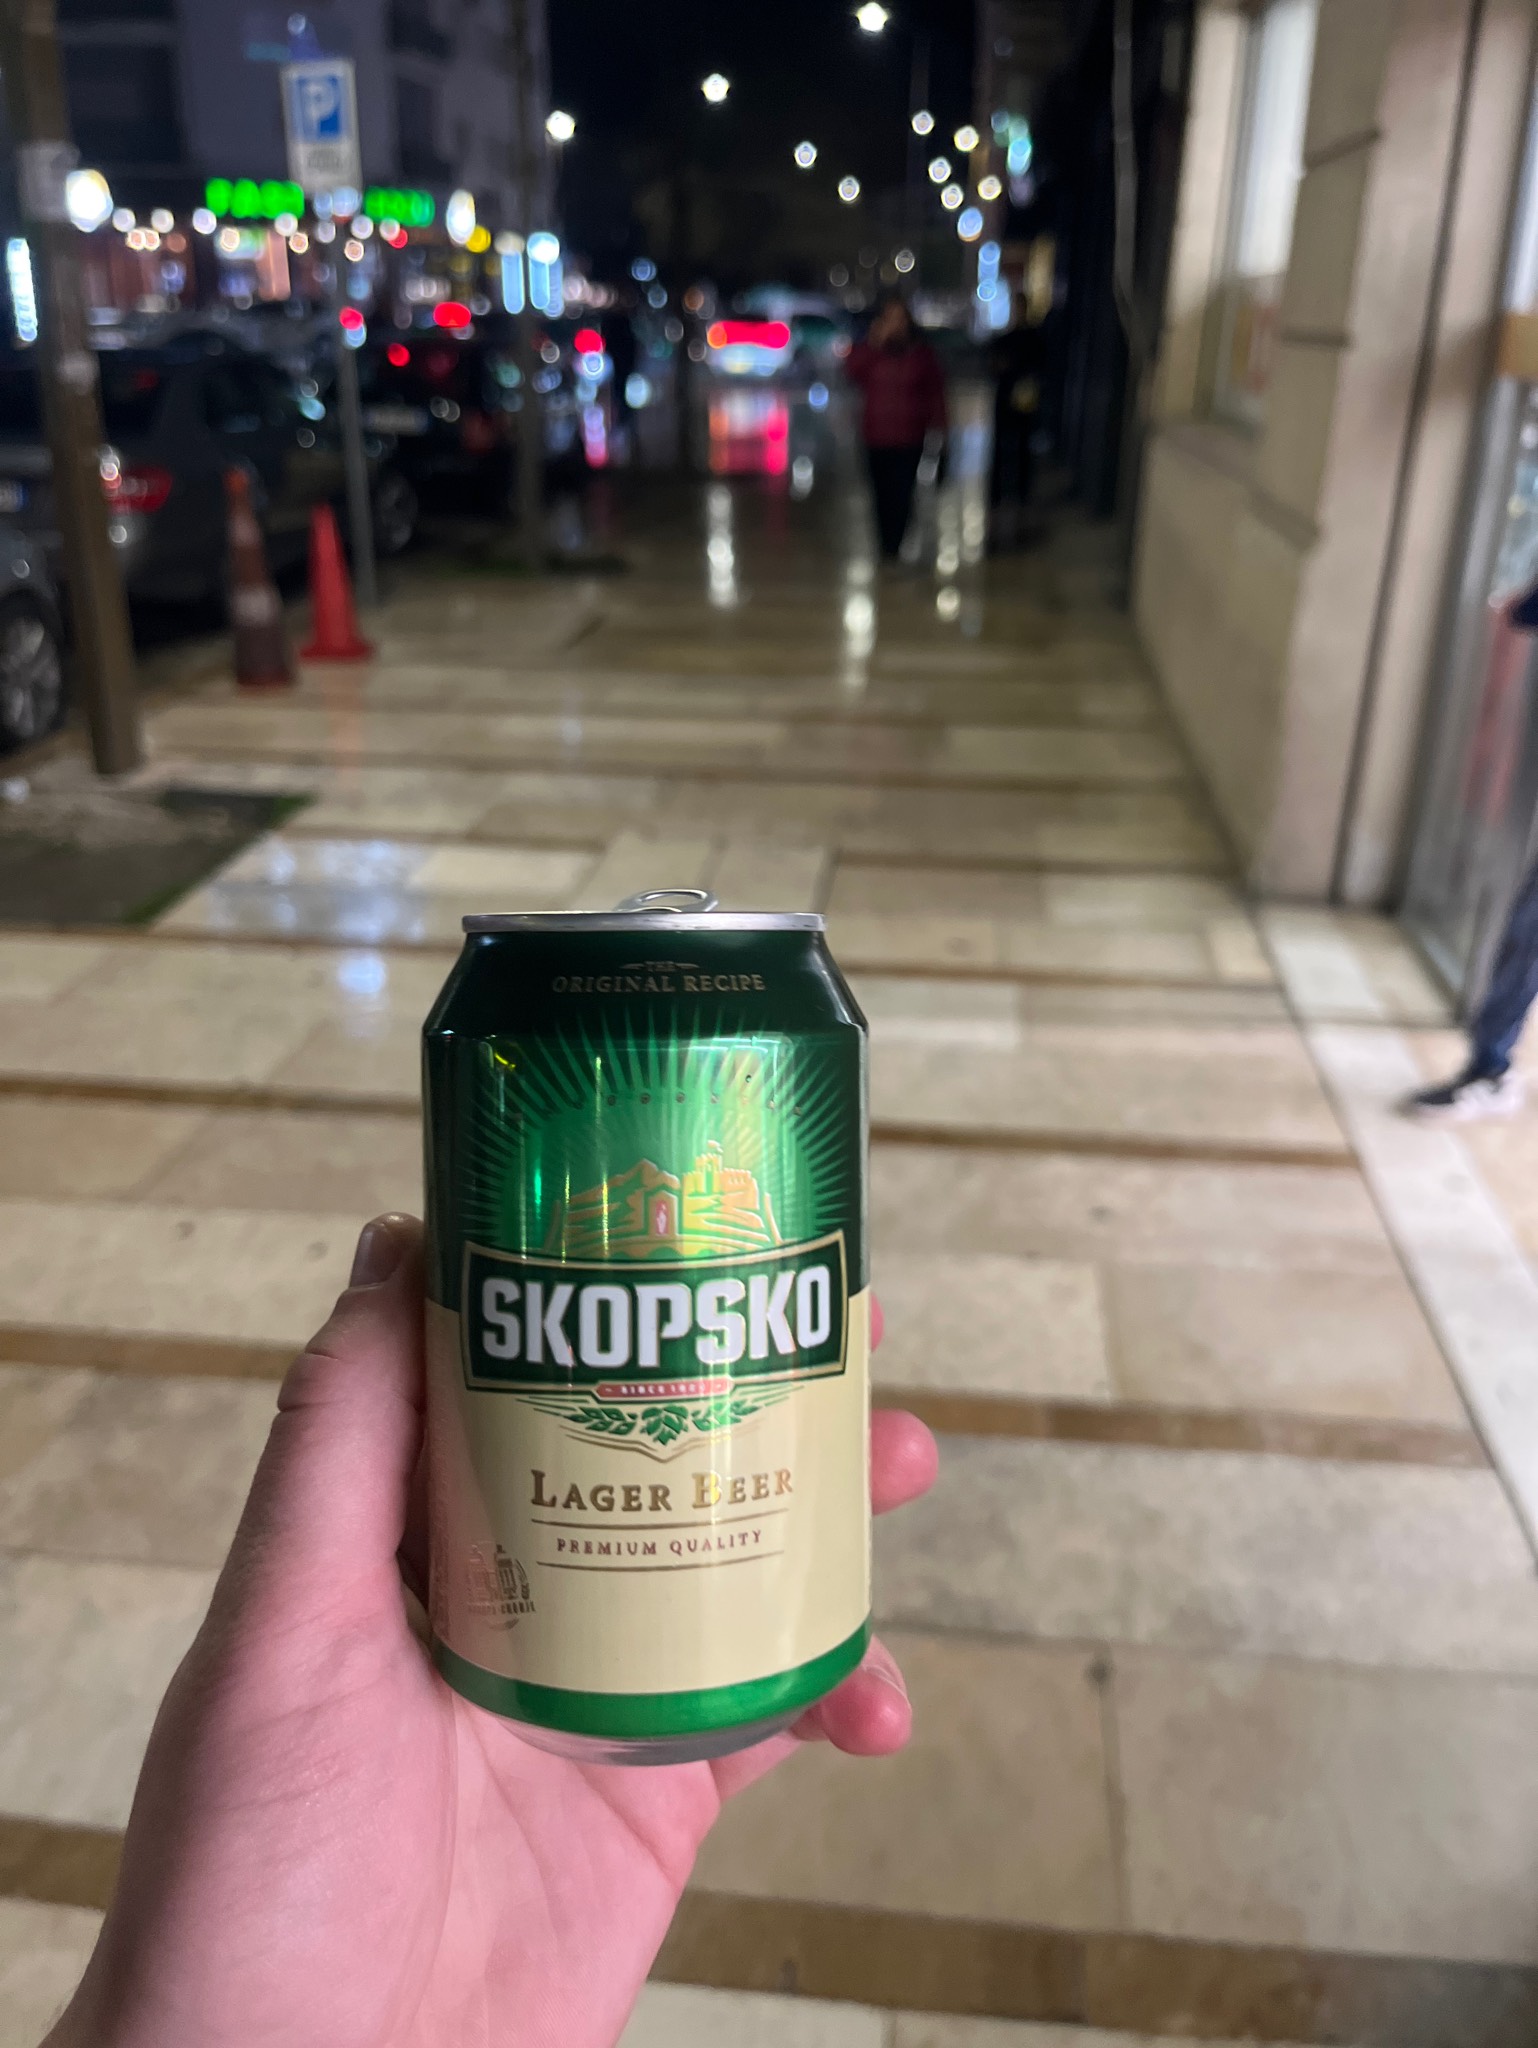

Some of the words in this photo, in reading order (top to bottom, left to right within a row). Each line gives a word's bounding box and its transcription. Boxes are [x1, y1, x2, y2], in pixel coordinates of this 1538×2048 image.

[551, 974, 677, 993] ORIGINAL
[682, 972, 767, 992] RECIPE
[481, 1264, 832, 1368] SKOPSKO
[556, 1537, 657, 1556] PREMIUM
[669, 1528, 763, 1557] QUALITY
